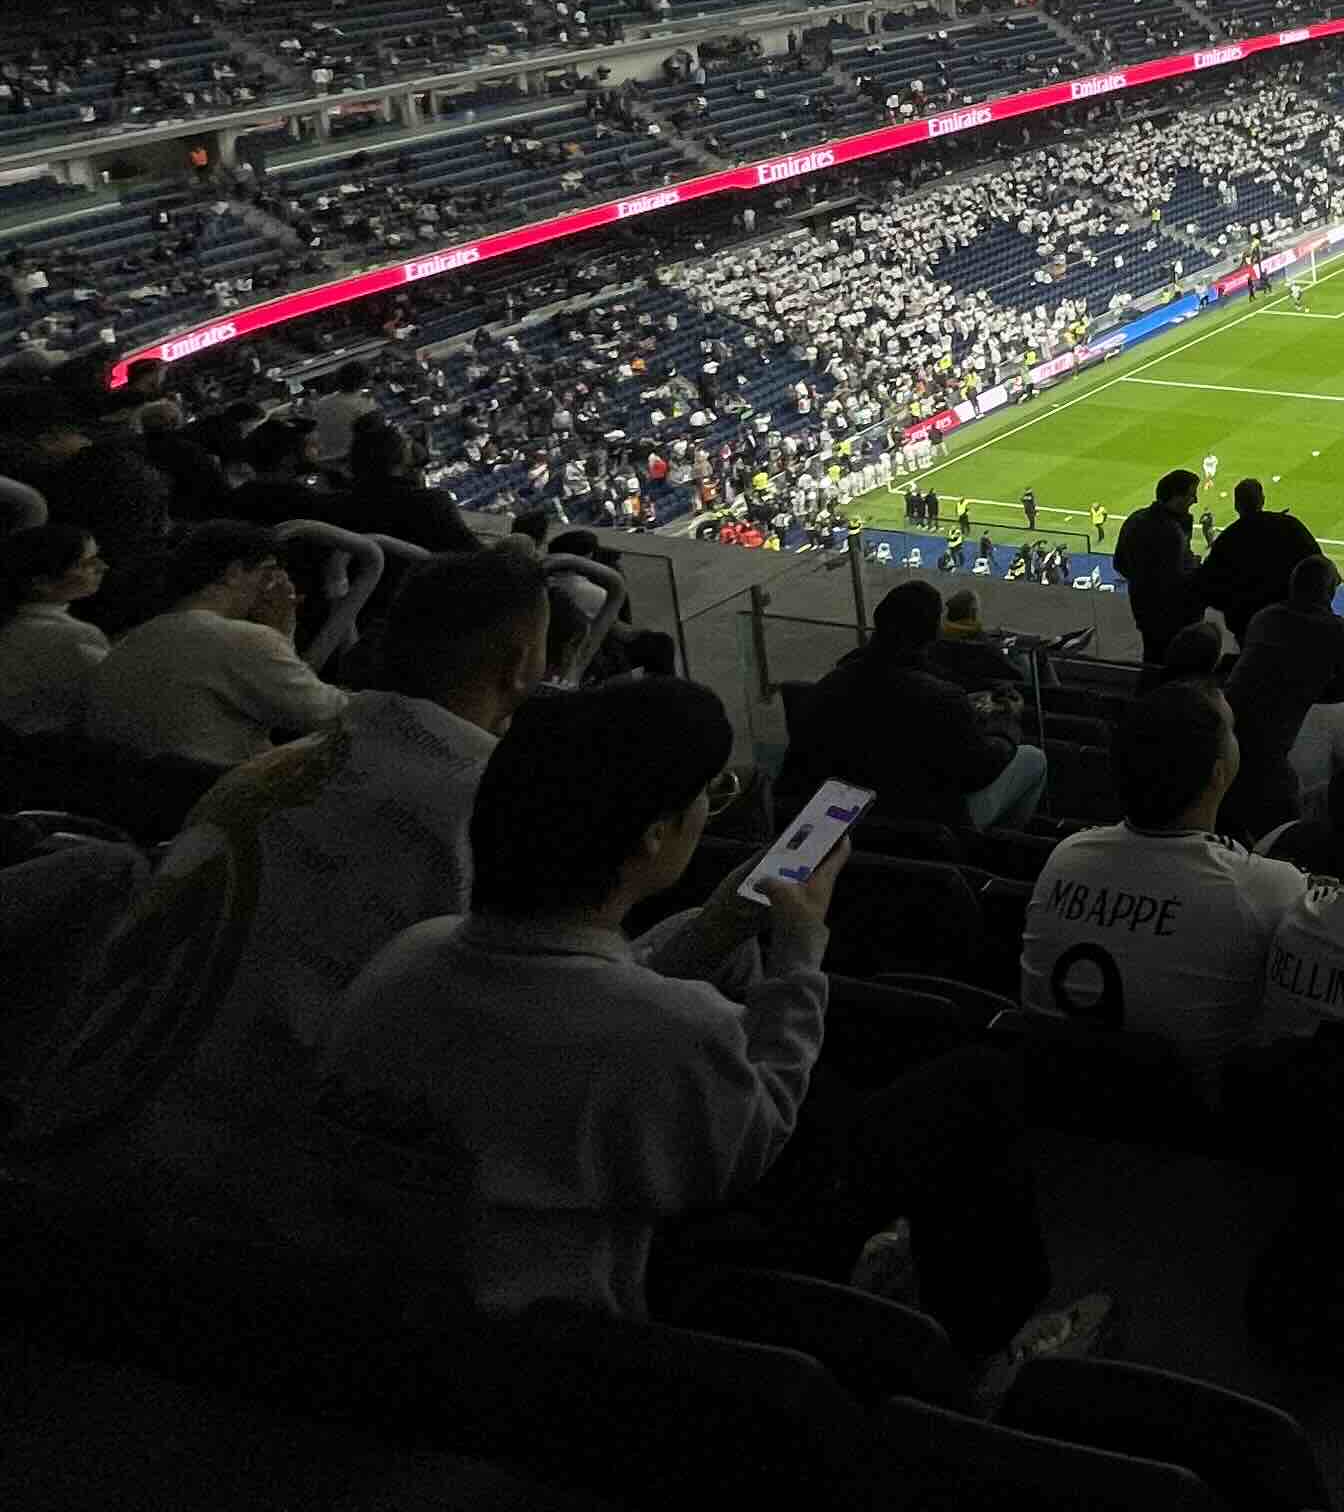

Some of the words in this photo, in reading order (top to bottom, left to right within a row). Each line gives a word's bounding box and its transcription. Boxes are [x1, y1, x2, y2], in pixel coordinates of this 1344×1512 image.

[1194, 47, 1243, 69] Emirates
[1072, 75, 1127, 99] Emirates
[928, 107, 992, 138] Emirates
[758, 149, 834, 185] Emirates
[618, 191, 680, 218] Emirates
[405, 247, 480, 282] Emirates
[162, 322, 236, 362] Emirates
[1048, 879, 1183, 937] MBAPPÉ
